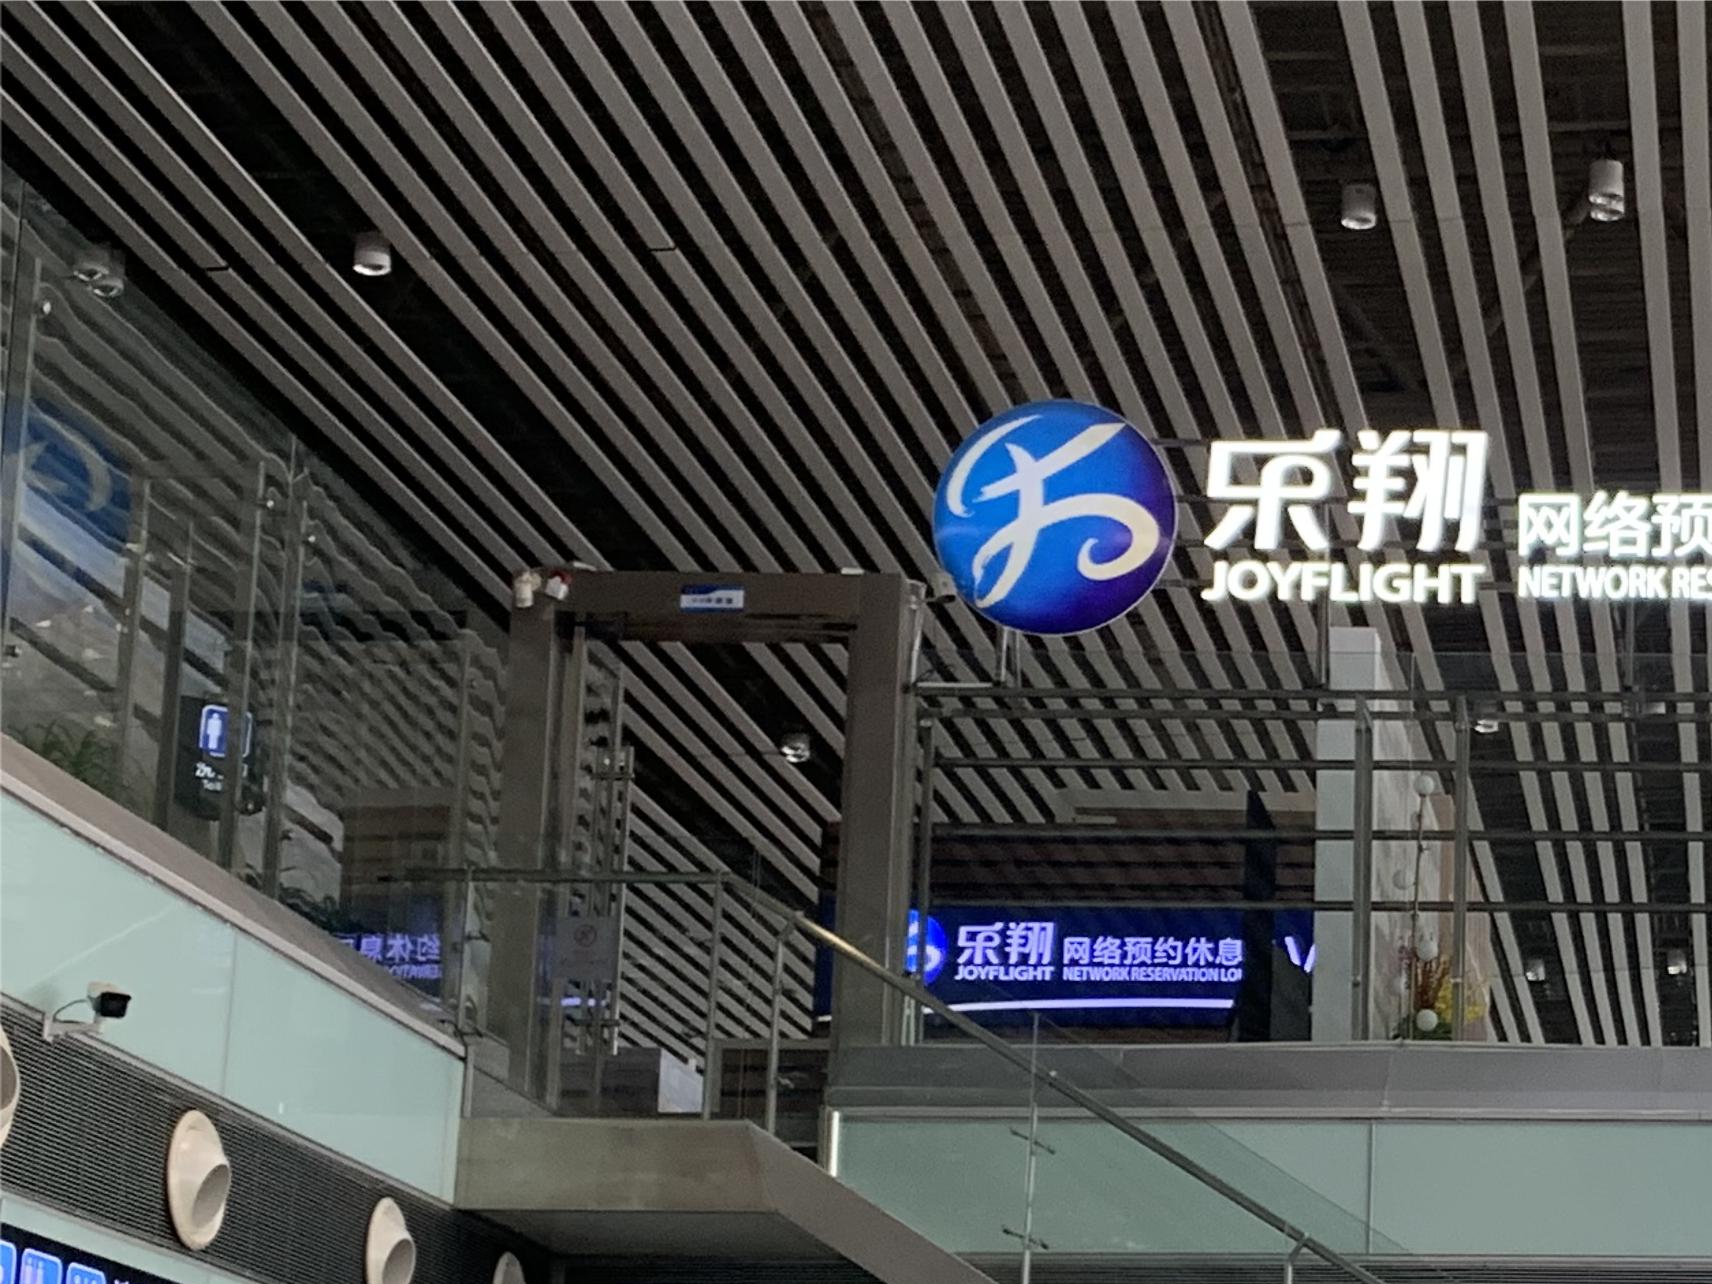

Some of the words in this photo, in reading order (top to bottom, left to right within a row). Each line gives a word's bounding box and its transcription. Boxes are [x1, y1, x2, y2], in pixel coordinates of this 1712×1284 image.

[1204, 428, 1489, 552] 乐翔
[1200, 559, 1486, 604] JOYFLIGHT
[1517, 565, 1667, 601] NETWORK
[956, 922, 1056, 966] 乐翔
[954, 965, 1054, 981] JOYFLIGHT
[1062, 966, 1129, 982] NETWORK
[1130, 966, 1218, 982] RESERVATION
